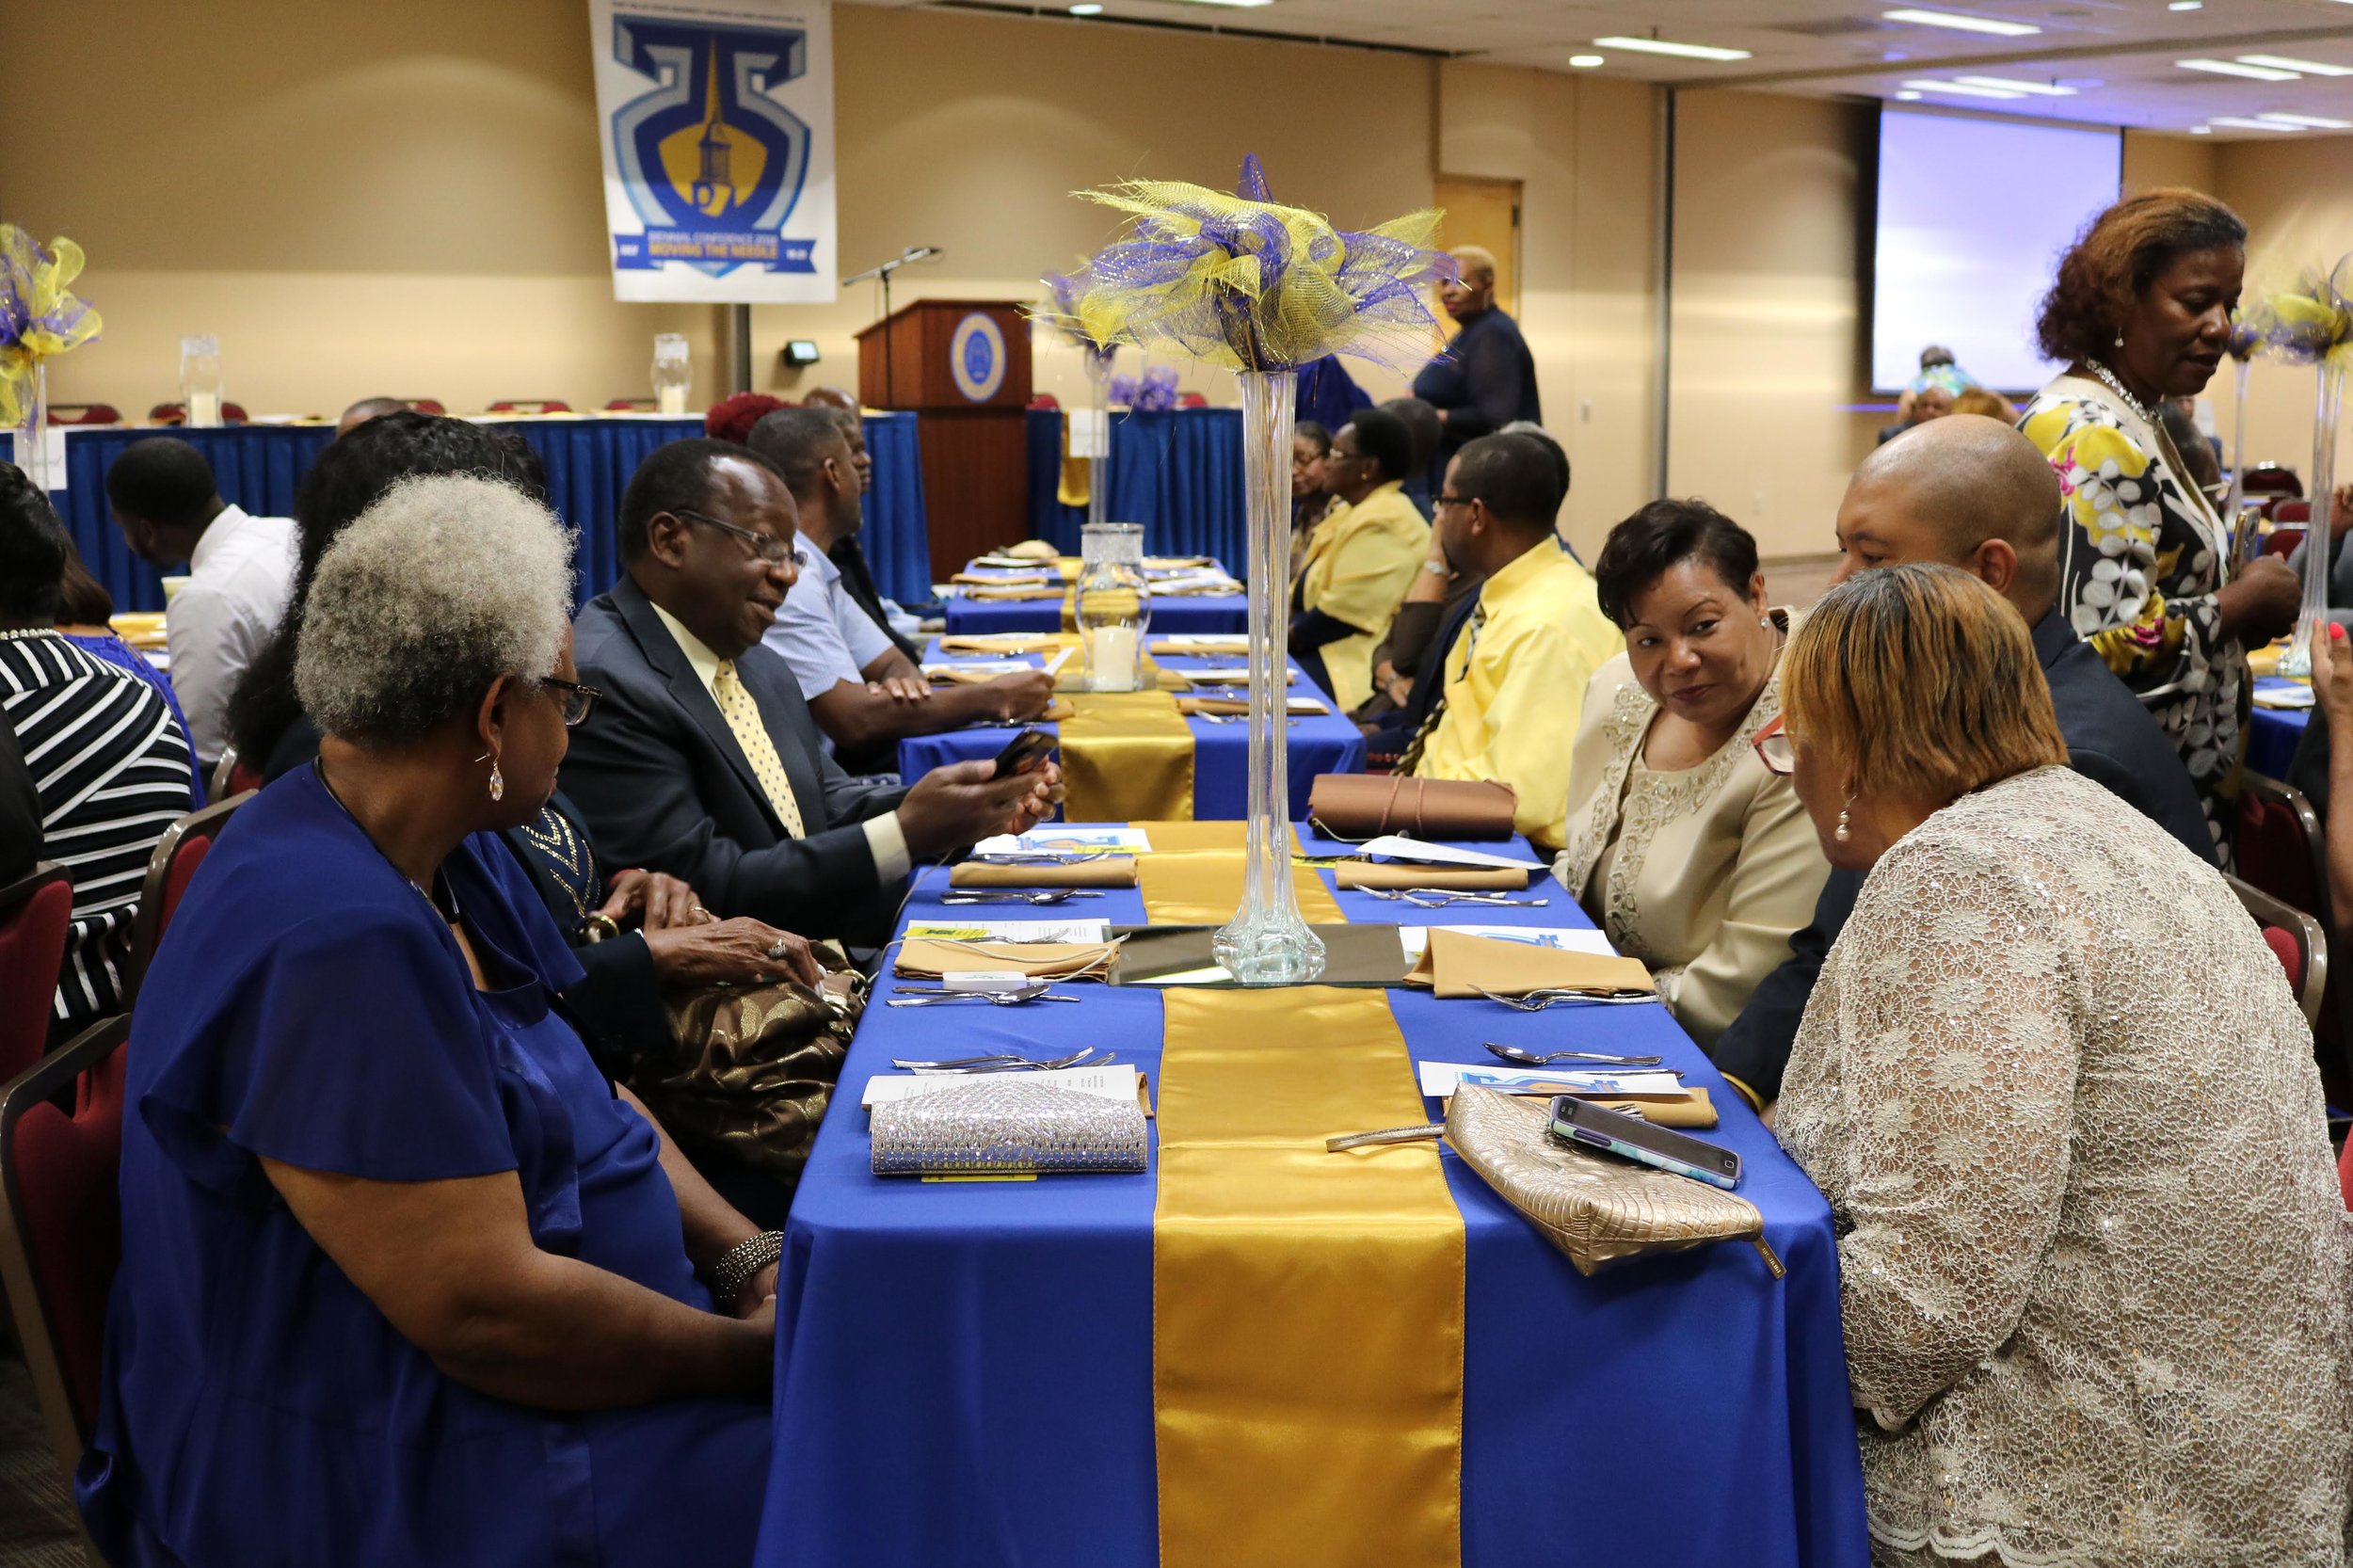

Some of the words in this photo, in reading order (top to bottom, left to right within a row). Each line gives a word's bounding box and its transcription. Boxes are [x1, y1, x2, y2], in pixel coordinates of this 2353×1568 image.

[648, 243, 702, 256] MOVING
[705, 244, 728, 257] THE
[730, 245, 778, 259] NEEDLE
